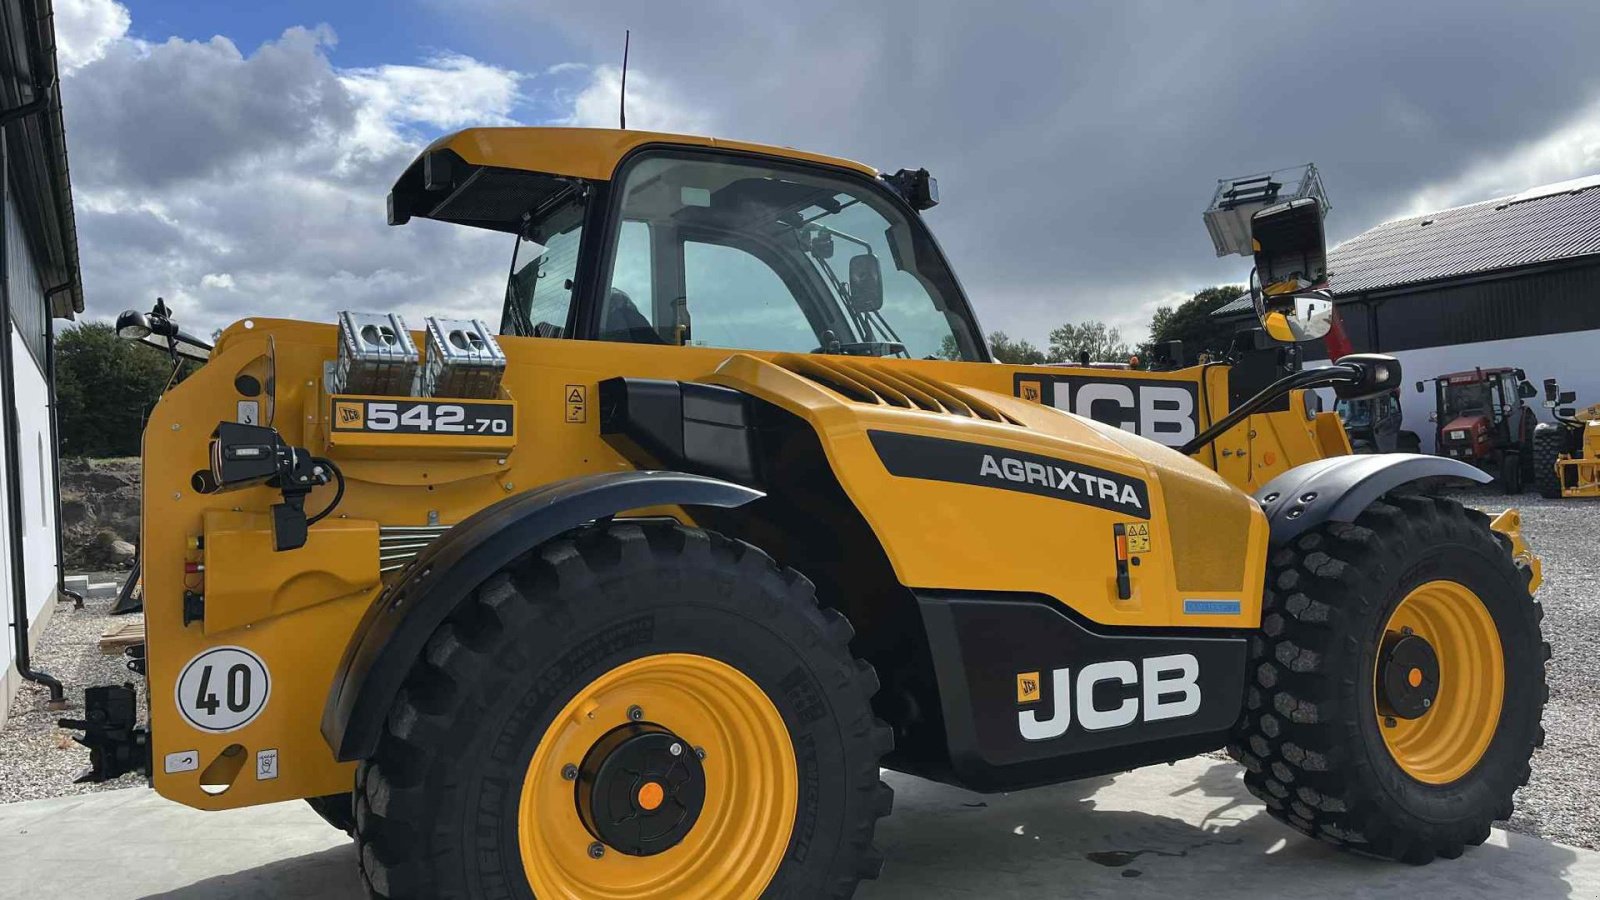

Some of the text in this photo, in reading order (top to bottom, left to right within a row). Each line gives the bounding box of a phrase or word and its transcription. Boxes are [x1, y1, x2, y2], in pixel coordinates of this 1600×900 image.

[341, 408, 361, 423] JCB
[367, 402, 507, 433] 542-70
[979, 454, 1142, 509] AGRIXTRA
[196, 663, 251, 715] 40
[1018, 653, 1201, 740] JCB
[1022, 679, 1037, 694] JCB
